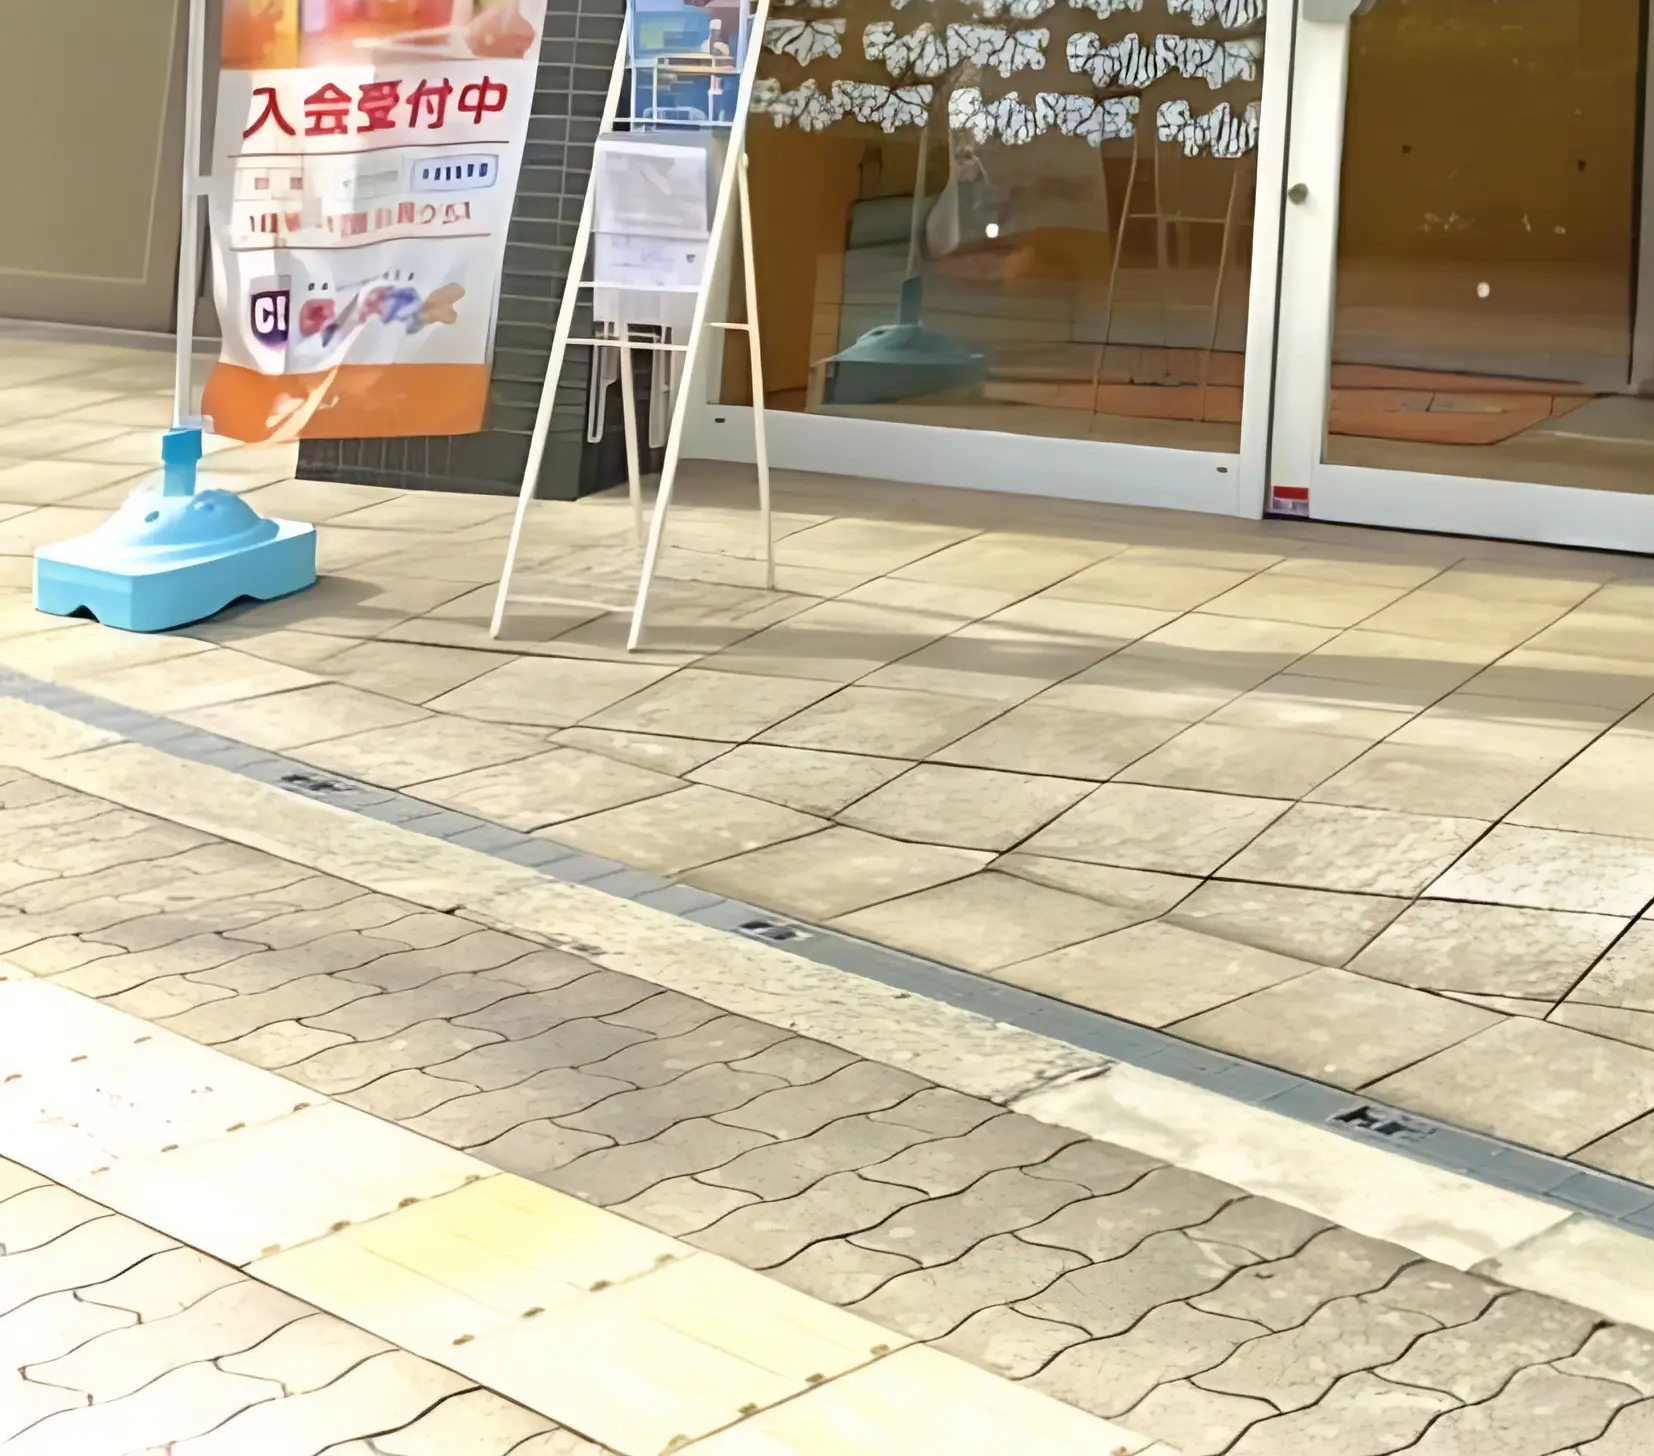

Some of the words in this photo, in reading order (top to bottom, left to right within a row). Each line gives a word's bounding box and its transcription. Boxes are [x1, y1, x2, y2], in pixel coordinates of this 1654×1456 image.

[243, 75, 508, 140] 入会受付中
